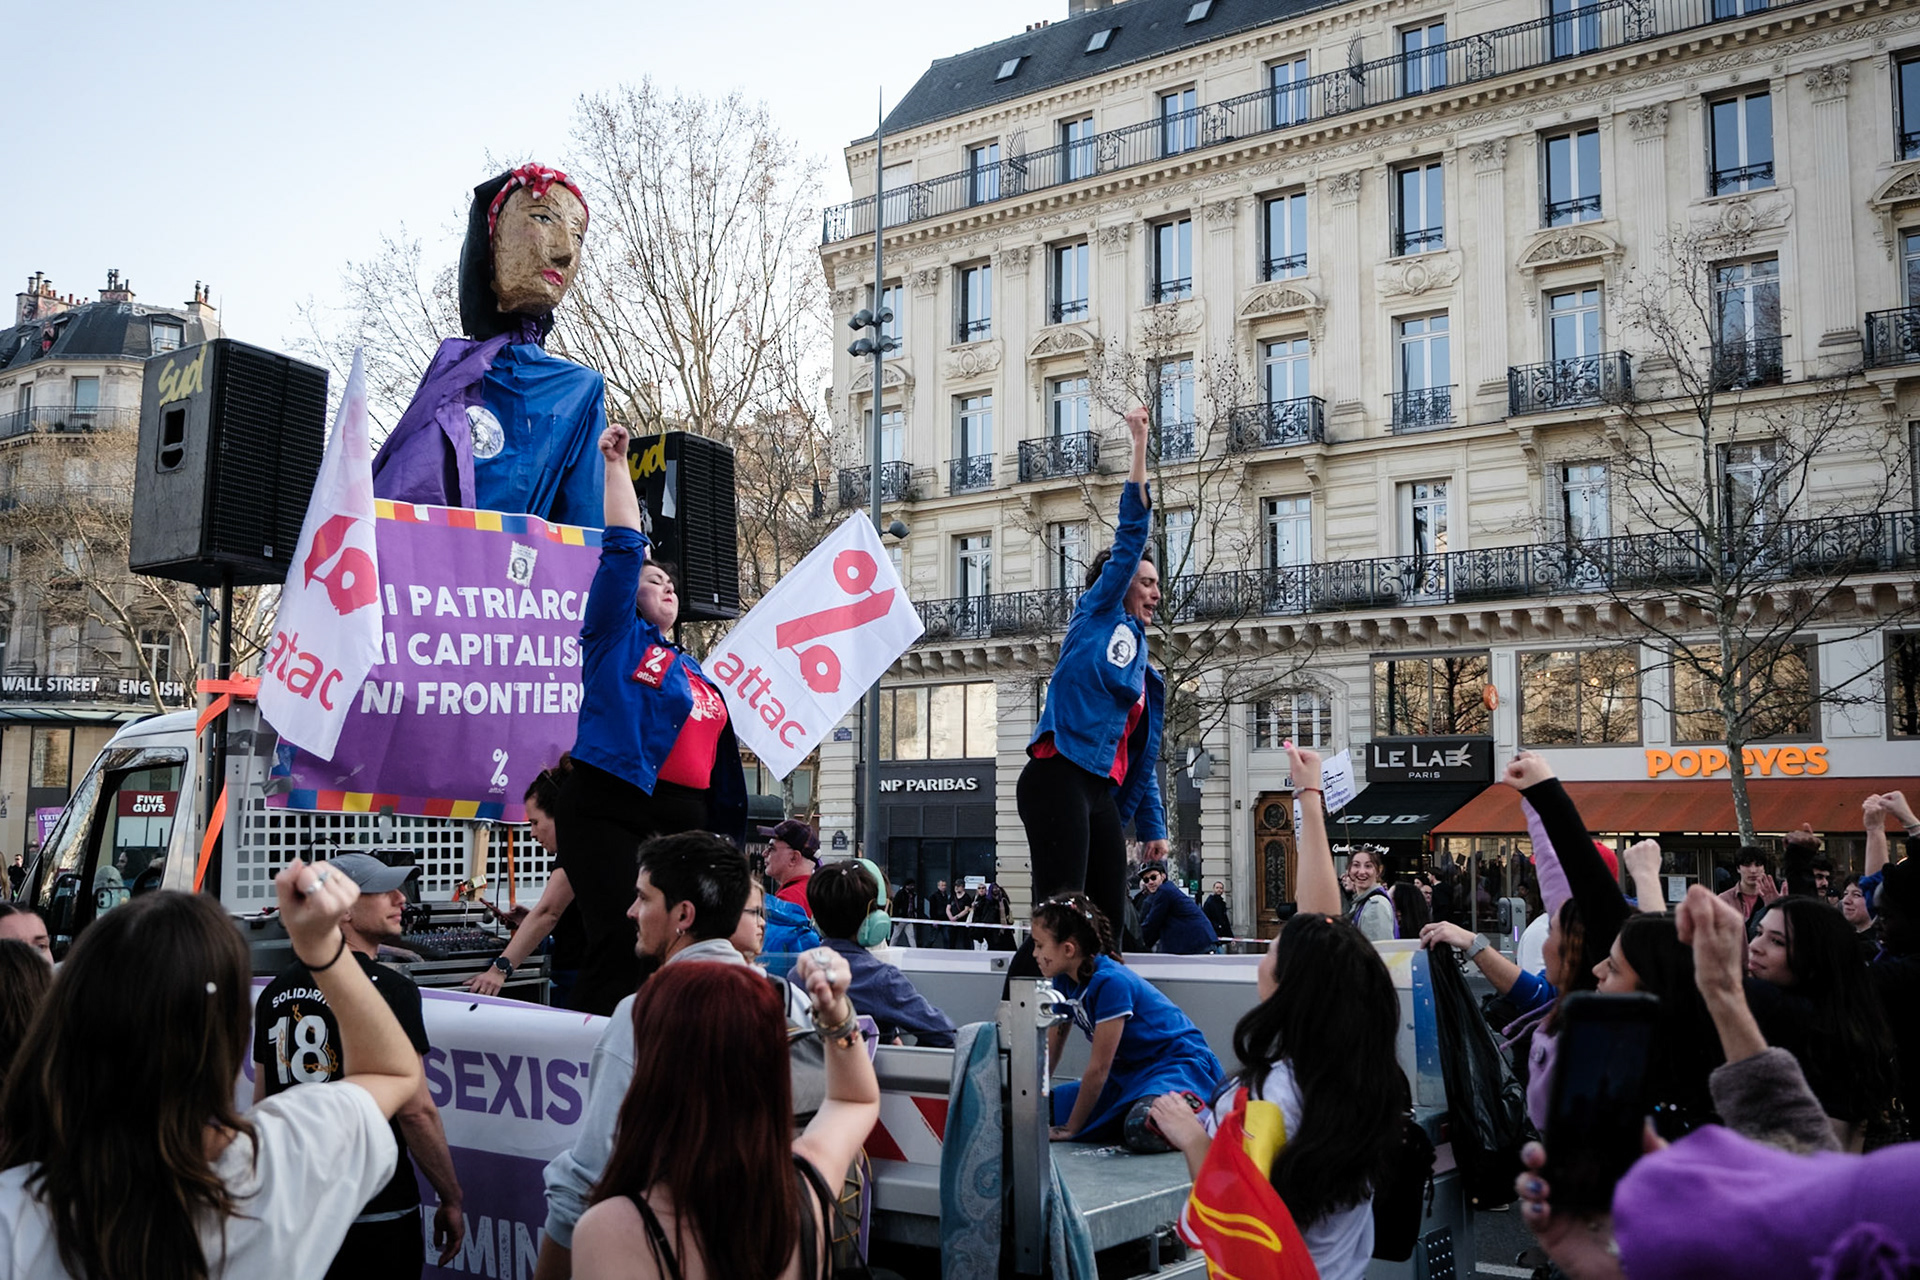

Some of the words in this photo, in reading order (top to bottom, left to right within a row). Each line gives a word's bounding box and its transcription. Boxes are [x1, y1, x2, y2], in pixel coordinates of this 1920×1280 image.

[628, 433, 667, 481] ud
[381, 584, 398, 615] I
[374, 632, 398, 665] I
[407, 632, 584, 667] CAPITALIS
[1, 676, 42, 692] WALL
[47, 677, 99, 692] STREET
[119, 680, 185, 696] ENGISH
[360, 681, 405, 714] NI
[416, 672, 585, 715] FRONTIÈR
[713, 652, 807, 750] attac
[1374, 744, 1406, 768] LE
[1412, 743, 1472, 768] LAB
[879, 779, 904, 792] NP
[906, 777, 978, 792] PARIBAS
[1408, 771, 1441, 779] PARIS
[132, 803, 166, 813] GUYS
[136, 794, 164, 804] FIVE
[1336, 814, 1423, 824] CBD
[268, 1014, 332, 1084] 18
